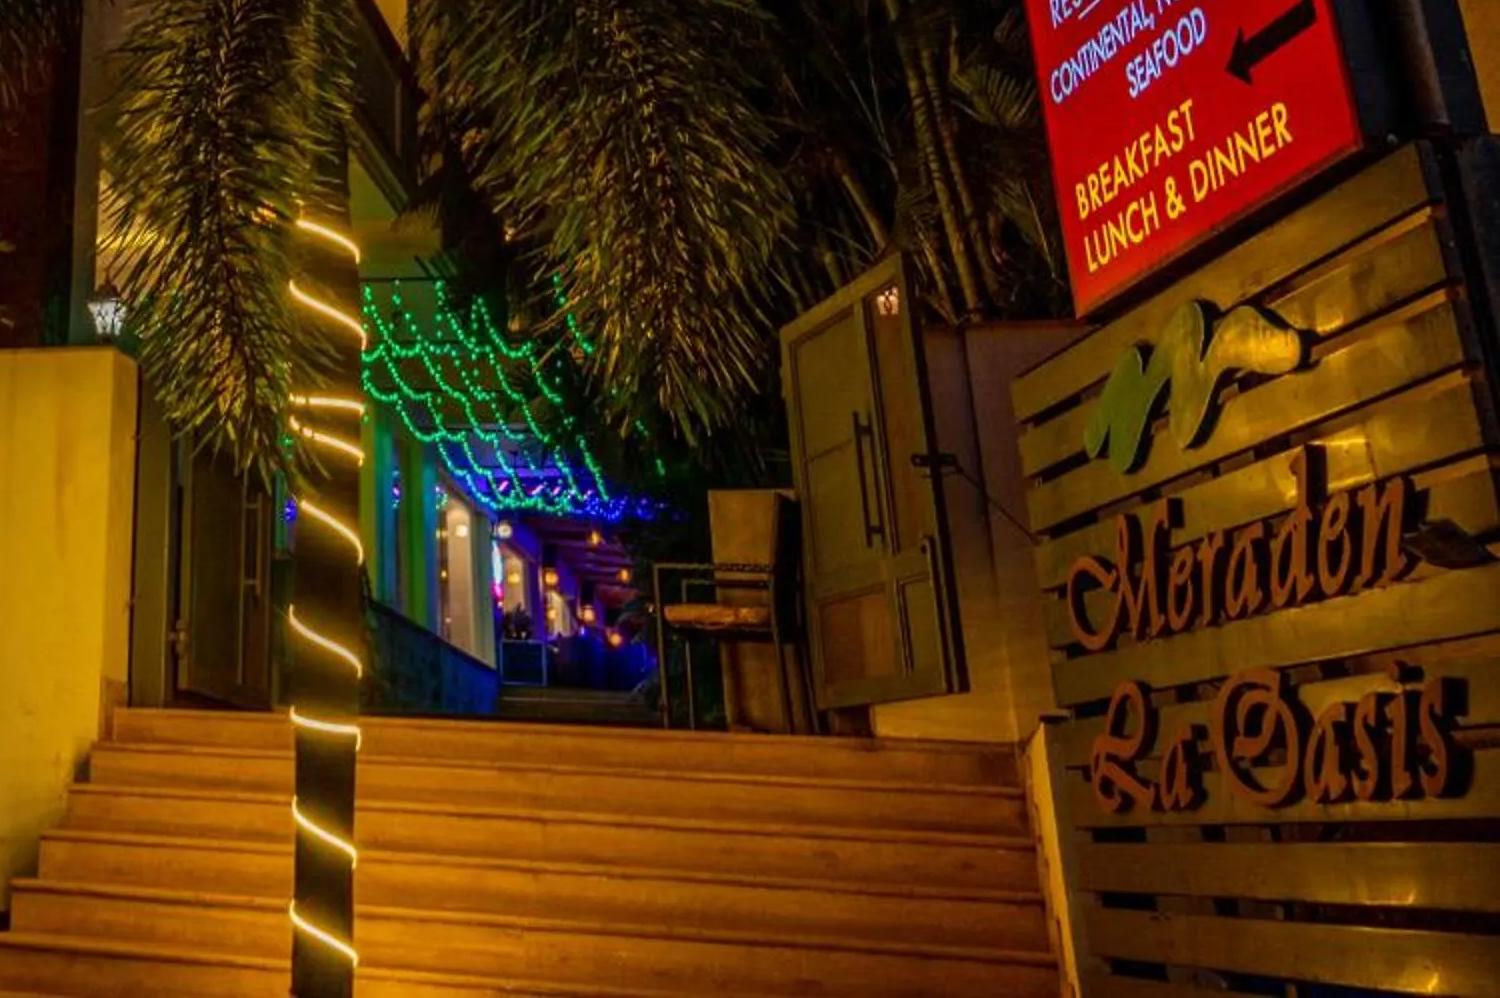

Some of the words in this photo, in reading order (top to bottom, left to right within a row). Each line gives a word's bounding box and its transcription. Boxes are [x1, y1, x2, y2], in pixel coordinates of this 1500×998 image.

[1125, 6, 1207, 99] SEAFOOD
[1075, 98, 1196, 221] BREAKFAST
[1083, 190, 1161, 274] LUNCH
[1164, 175, 1187, 220] &
[1188, 101, 1294, 203] DINNER
[1066, 443, 1410, 652] Meraden
[1091, 680, 1200, 813] La
[1212, 660, 1451, 807] Oasis
